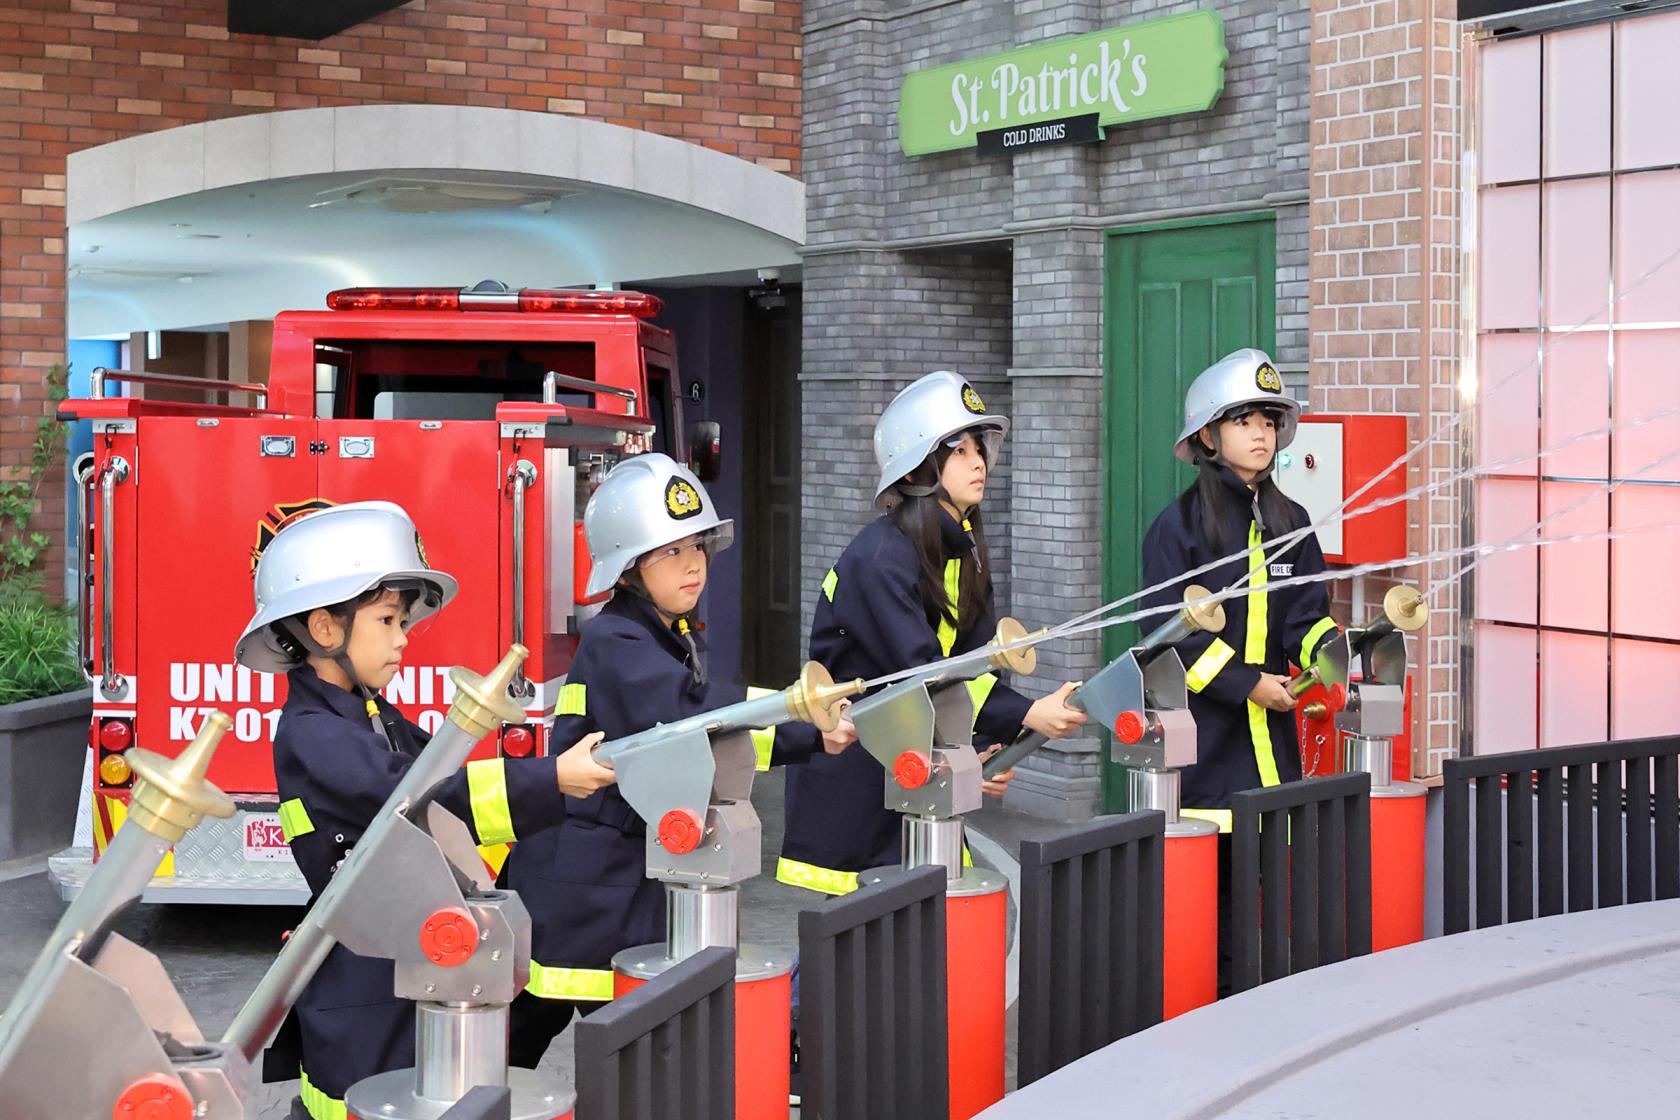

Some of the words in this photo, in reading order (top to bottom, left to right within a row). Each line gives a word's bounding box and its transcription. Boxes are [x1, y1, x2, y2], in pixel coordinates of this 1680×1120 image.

[950, 73, 990, 136] St.
[991, 39, 1147, 119] Patrick's
[1003, 129, 1027, 147] COLD
[1028, 123, 1066, 143] DRINKS
[692, 383, 699, 400] 6
[1271, 565, 1285, 574] FIRE
[170, 662, 275, 703] UNIT
[379, 665, 457, 705] NIT
